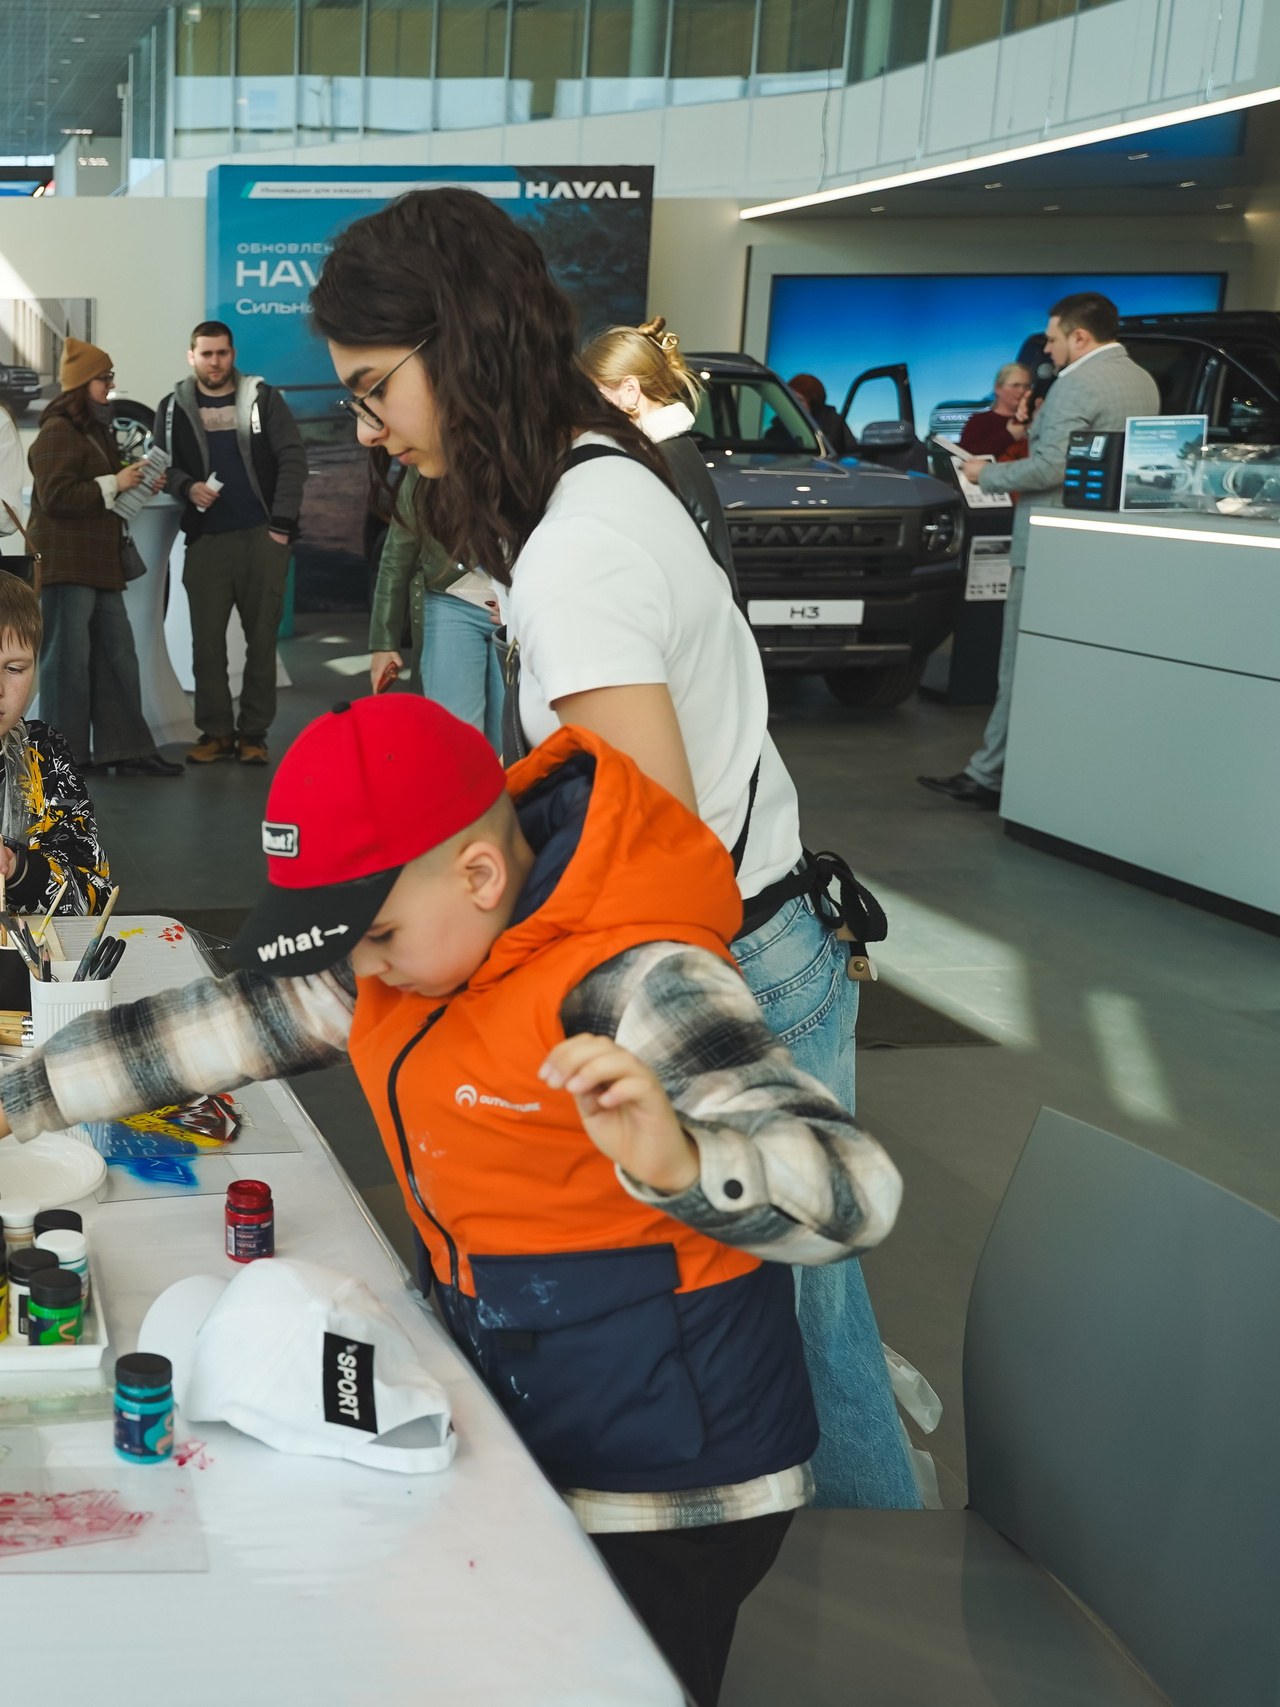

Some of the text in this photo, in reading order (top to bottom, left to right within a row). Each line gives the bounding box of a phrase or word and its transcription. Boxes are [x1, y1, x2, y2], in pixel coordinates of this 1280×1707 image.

[525, 181, 640, 199] HAVAL
[790, 606, 820, 619] H3
[257, 925, 325, 963] what
[336, 1351, 360, 1420] SPORT
